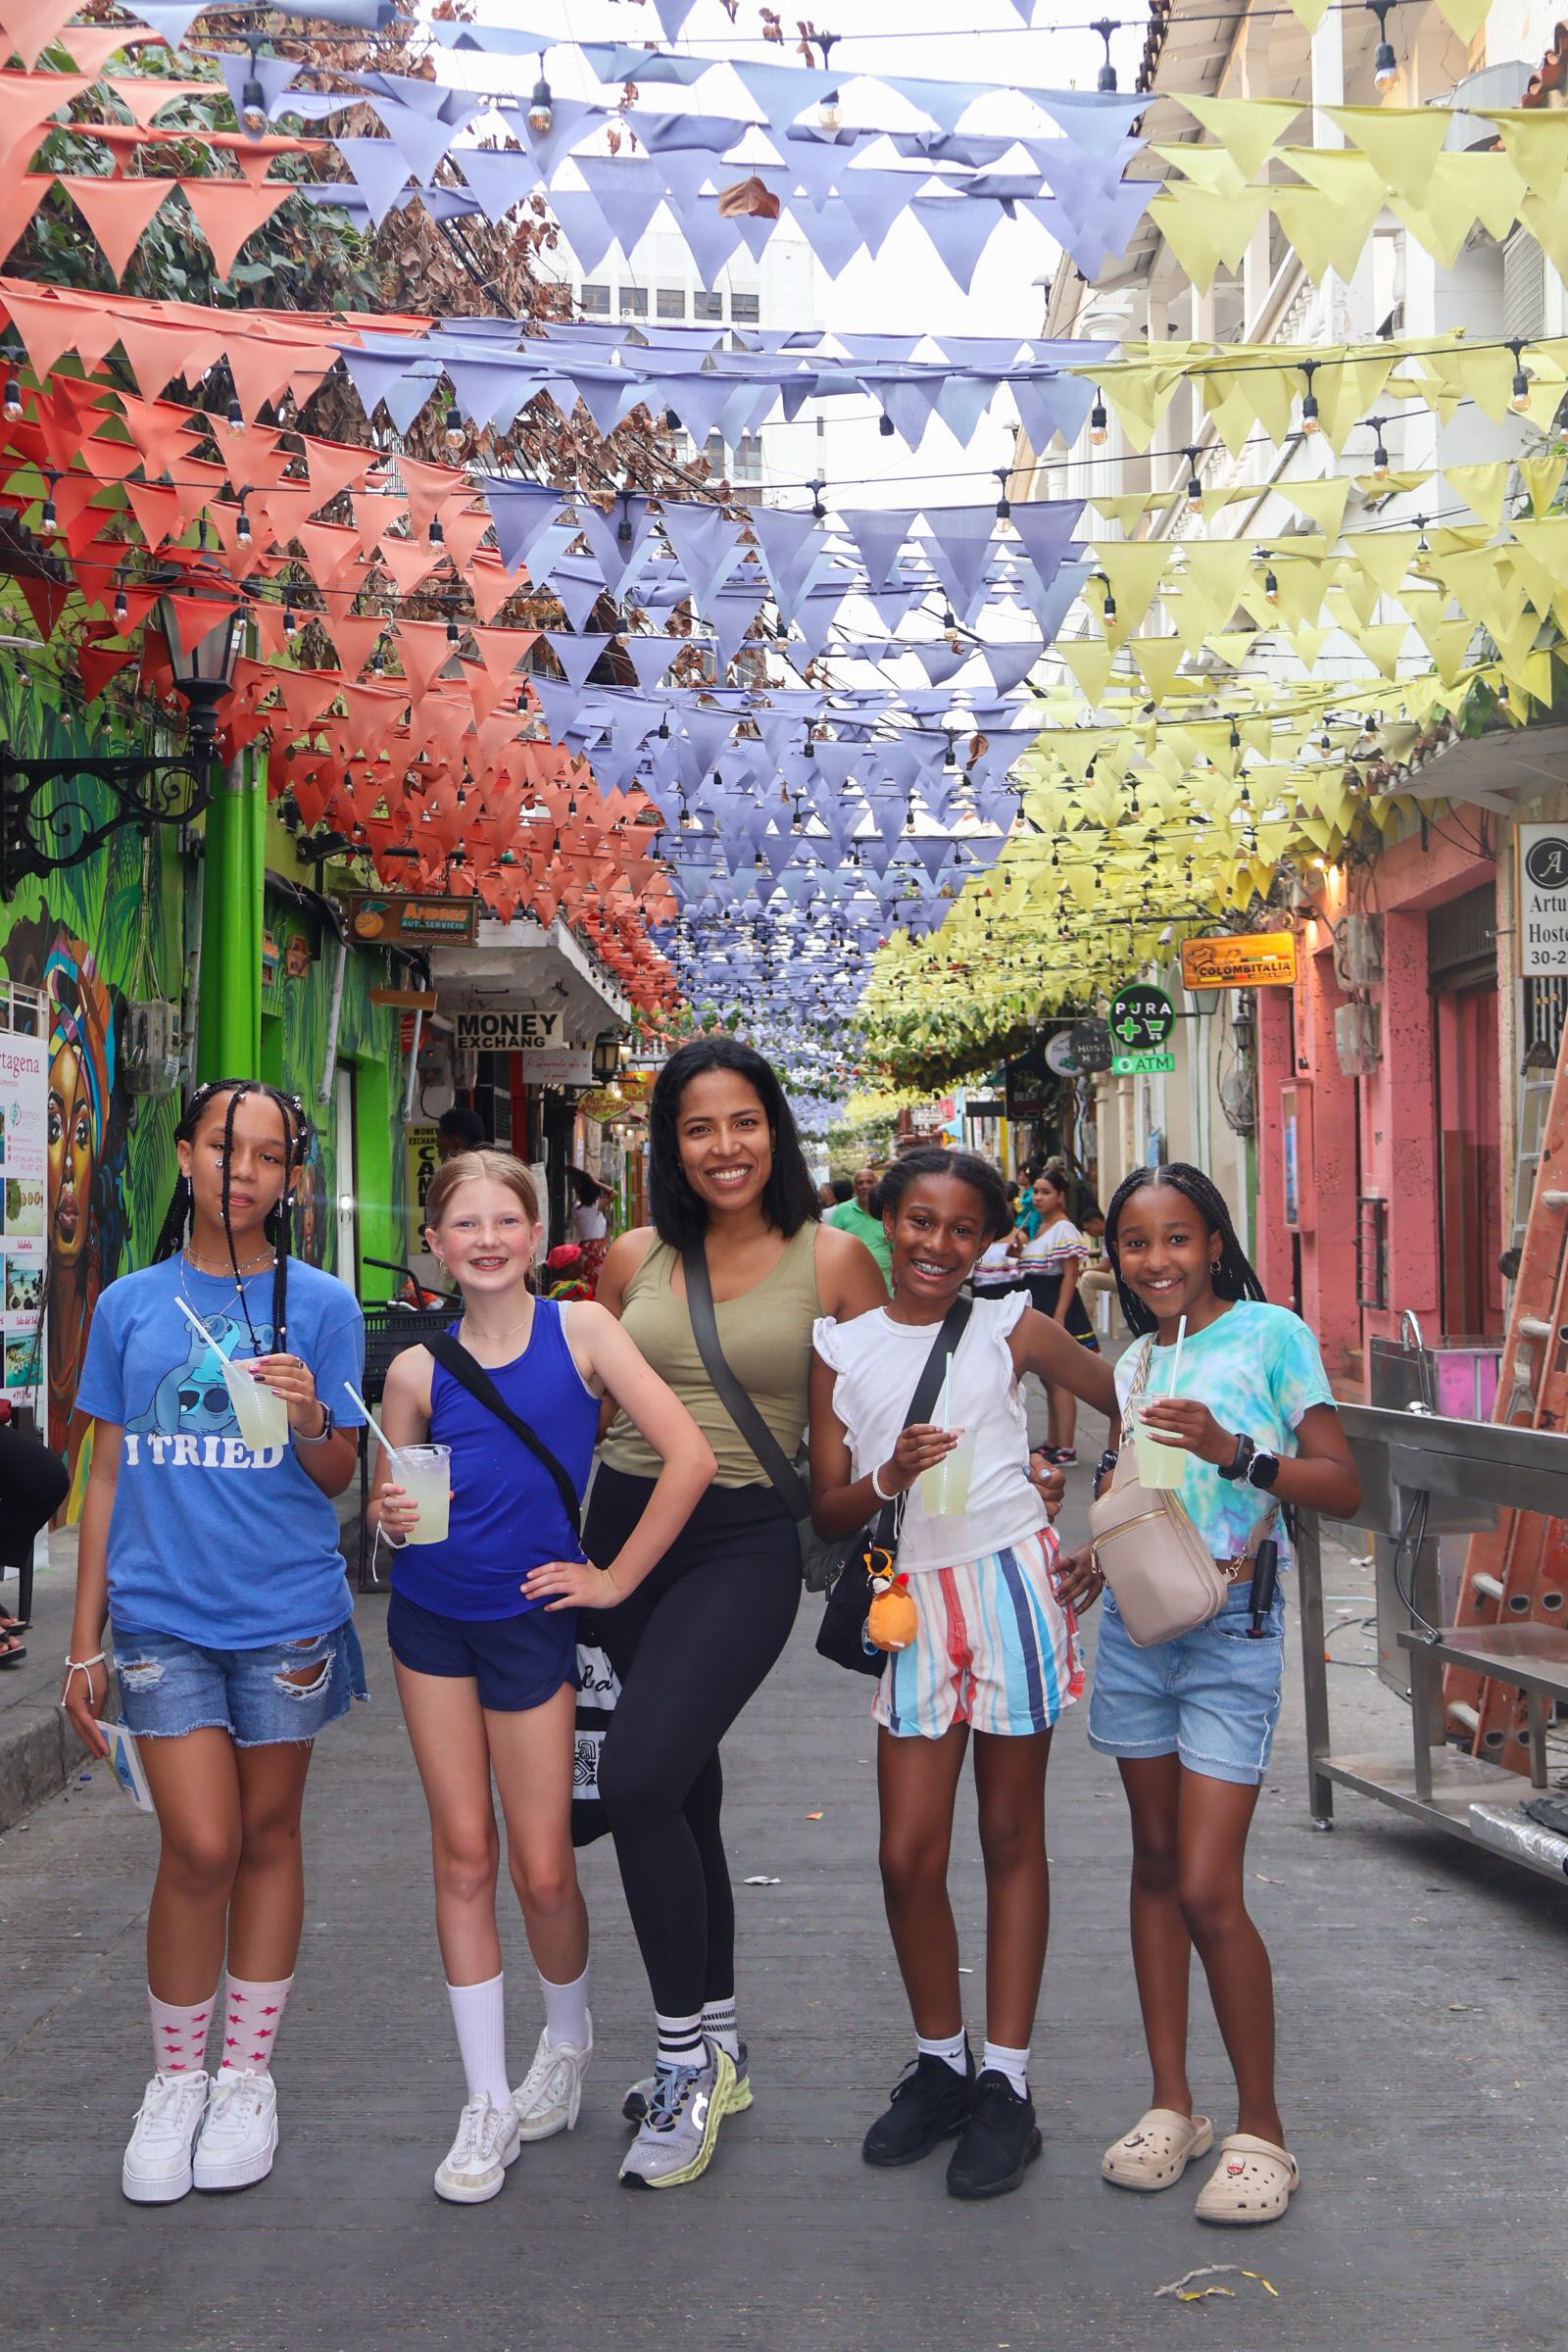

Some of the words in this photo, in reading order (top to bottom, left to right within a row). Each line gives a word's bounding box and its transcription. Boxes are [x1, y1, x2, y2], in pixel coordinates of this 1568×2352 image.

[1199, 961, 1292, 977] COLOMBITALIA
[1115, 1002, 1172, 1014] PURA
[457, 1013, 558, 1036] MONEY
[458, 1036, 546, 1049] EXCHANG
[1136, 1056, 1169, 1070] ATM
[124, 1434, 140, 1466] I
[147, 1434, 284, 1469] TRIED
